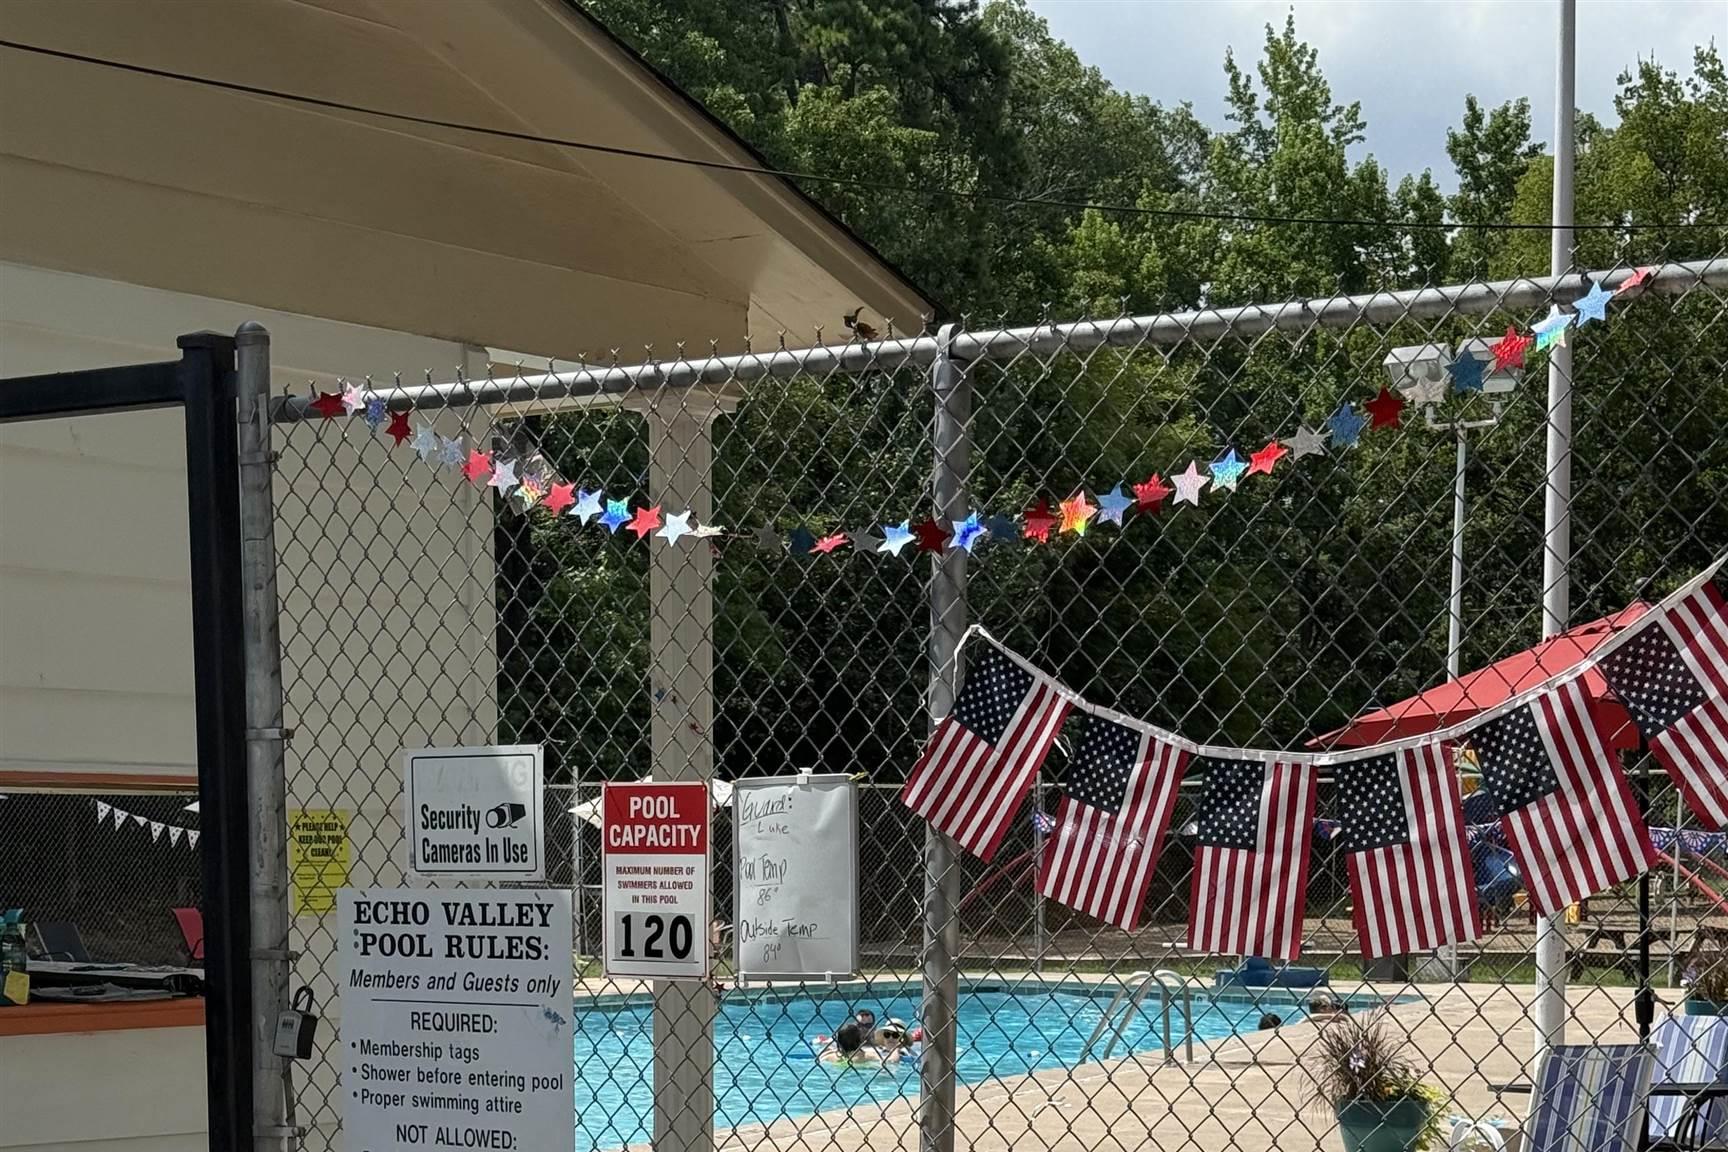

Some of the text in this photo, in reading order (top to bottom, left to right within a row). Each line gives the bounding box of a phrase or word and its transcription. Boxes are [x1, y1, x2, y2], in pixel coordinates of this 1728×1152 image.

[421, 804, 481, 835] Security
[629, 796, 681, 819] POOL
[609, 824, 702, 847] CAPACITY
[422, 837, 528, 863] Cameras In Use
[616, 866, 696, 876] MAXIMUM NUMBER OF
[617, 880, 693, 890] SWIMMERS ALLOWED
[632, 895, 679, 904] IN THIS POOL
[353, 901, 554, 927] ECHO VALLEY
[621, 913, 693, 959] 120
[741, 917, 818, 943] Outside Temp
[360, 933, 549, 960] POOL RULES:
[350, 969, 561, 998] Members and Guests only
[410, 1011, 498, 1034] REQUIRED:
[360, 1038, 480, 1064] Membership tags
[361, 1063, 563, 1093] Shower before entering pool
[361, 1088, 522, 1115] Proper swimming attire
[396, 1124, 517, 1150] NOT ALLOWED:
